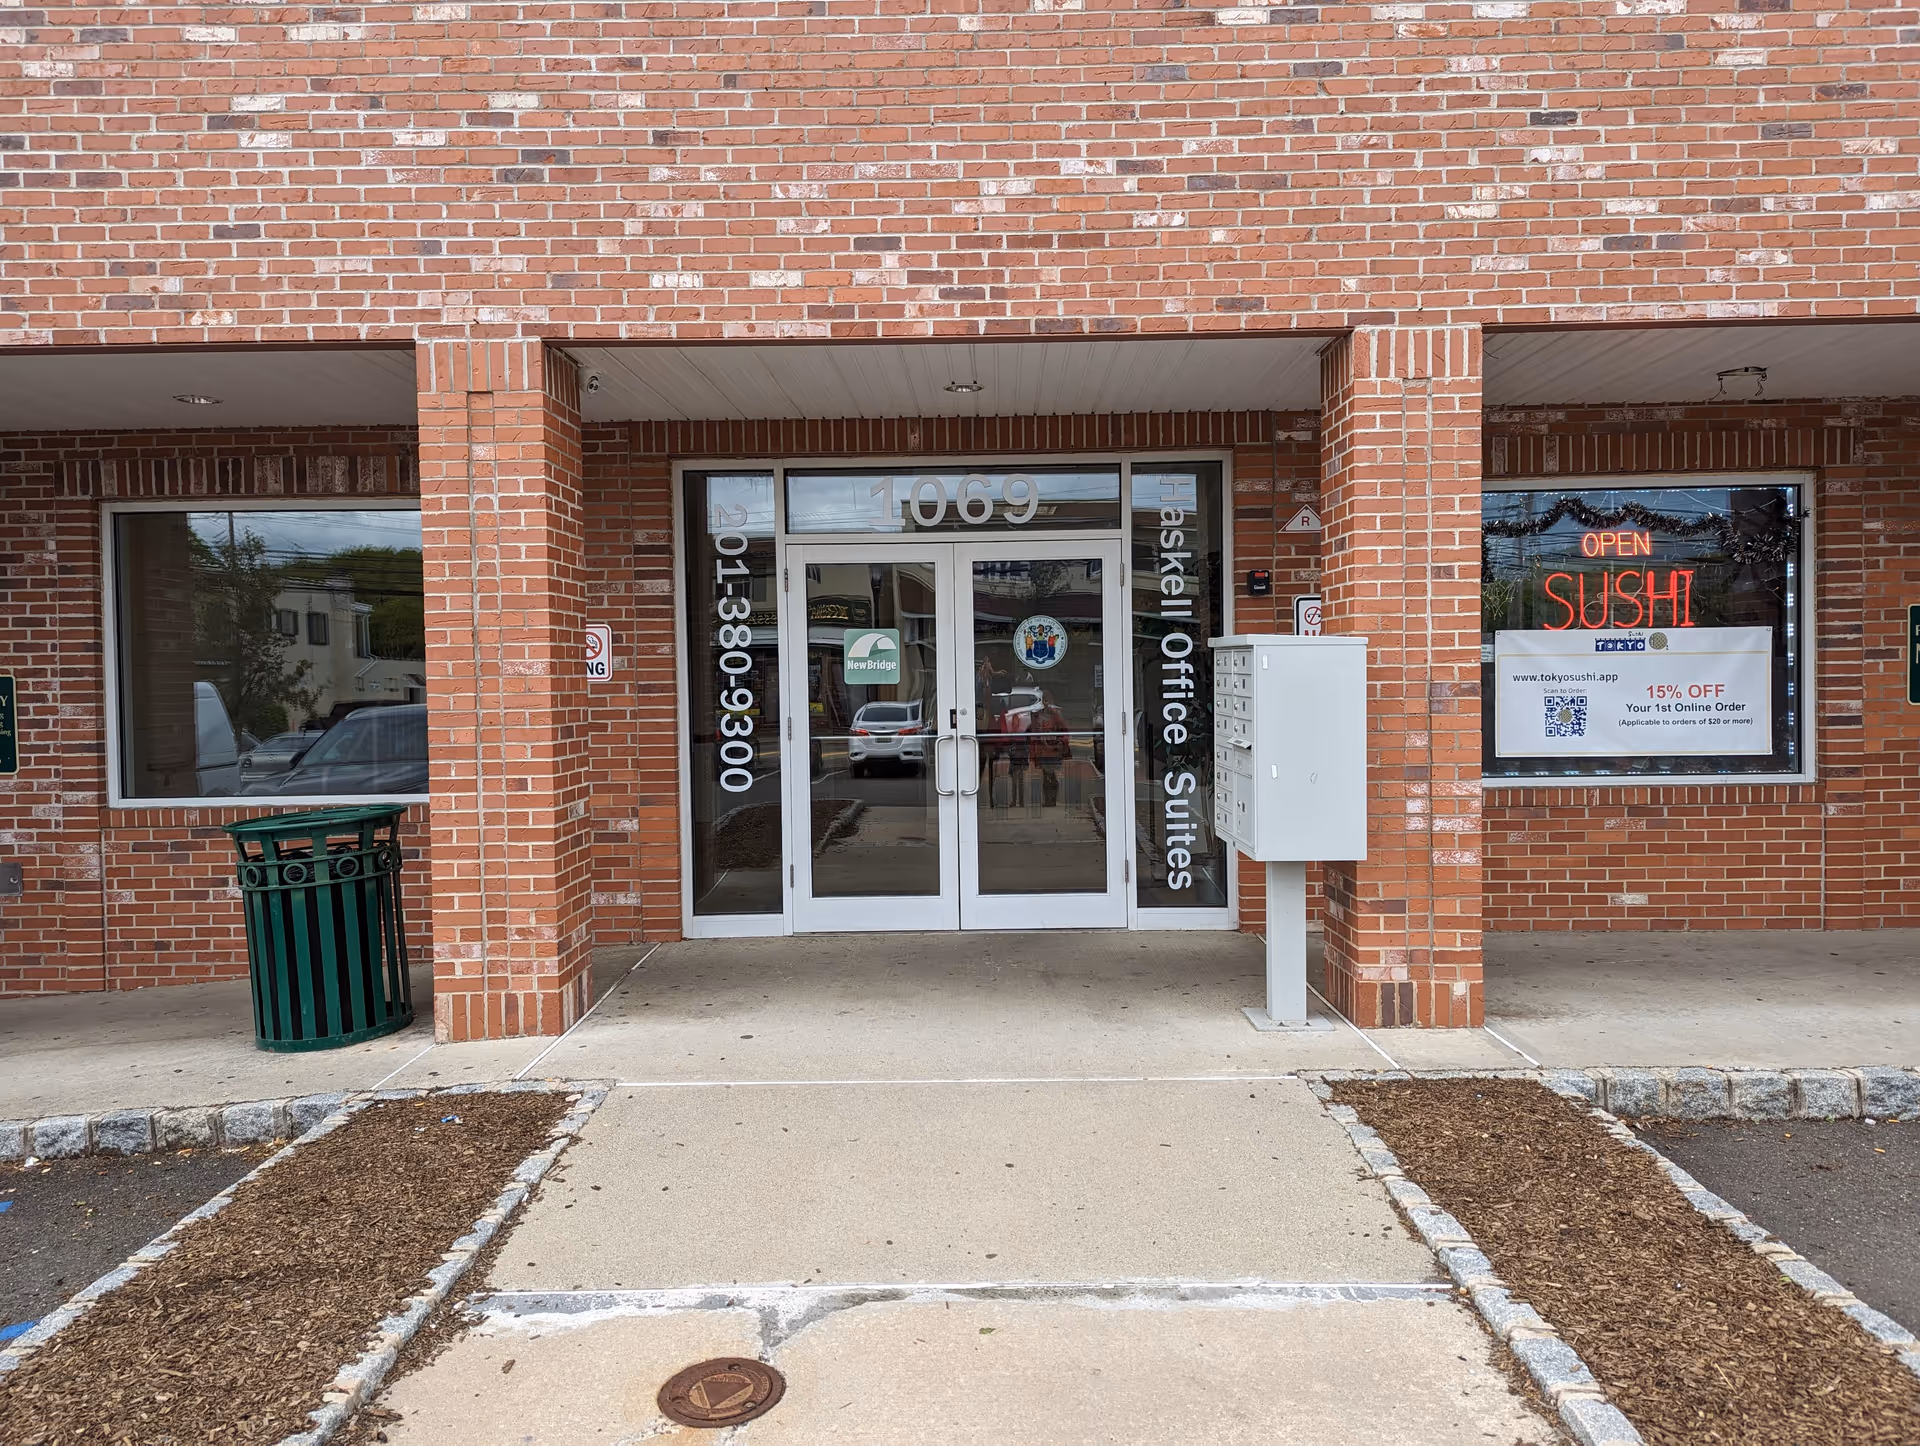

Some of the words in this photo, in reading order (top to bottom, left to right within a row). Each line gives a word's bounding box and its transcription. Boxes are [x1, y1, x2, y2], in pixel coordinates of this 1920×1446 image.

[869, 474, 1038, 527] 1069
[1302, 516, 1310, 526] R
[1160, 477, 1192, 616] Haskell
[1583, 531, 1650, 557] OPEN
[1543, 570, 1695, 630] SUSHI
[715, 503, 753, 792] 201-380-9300
[1161, 632, 1194, 744] Office
[1512, 672, 1619, 683] www.tokyosushi.app
[1646, 684, 1682, 699] 15%
[1688, 684, 1725, 698] OFF
[1618, 719, 1661, 727] (Applicable
[1671, 718, 1697, 726] orders
[1732, 717, 1753, 725] more)
[1626, 703, 1652, 713] Your
[1655, 703, 1672, 712] 1st
[1675, 702, 1712, 712] Online
[1715, 702, 1746, 712] Order
[1164, 771, 1197, 890] Suites
